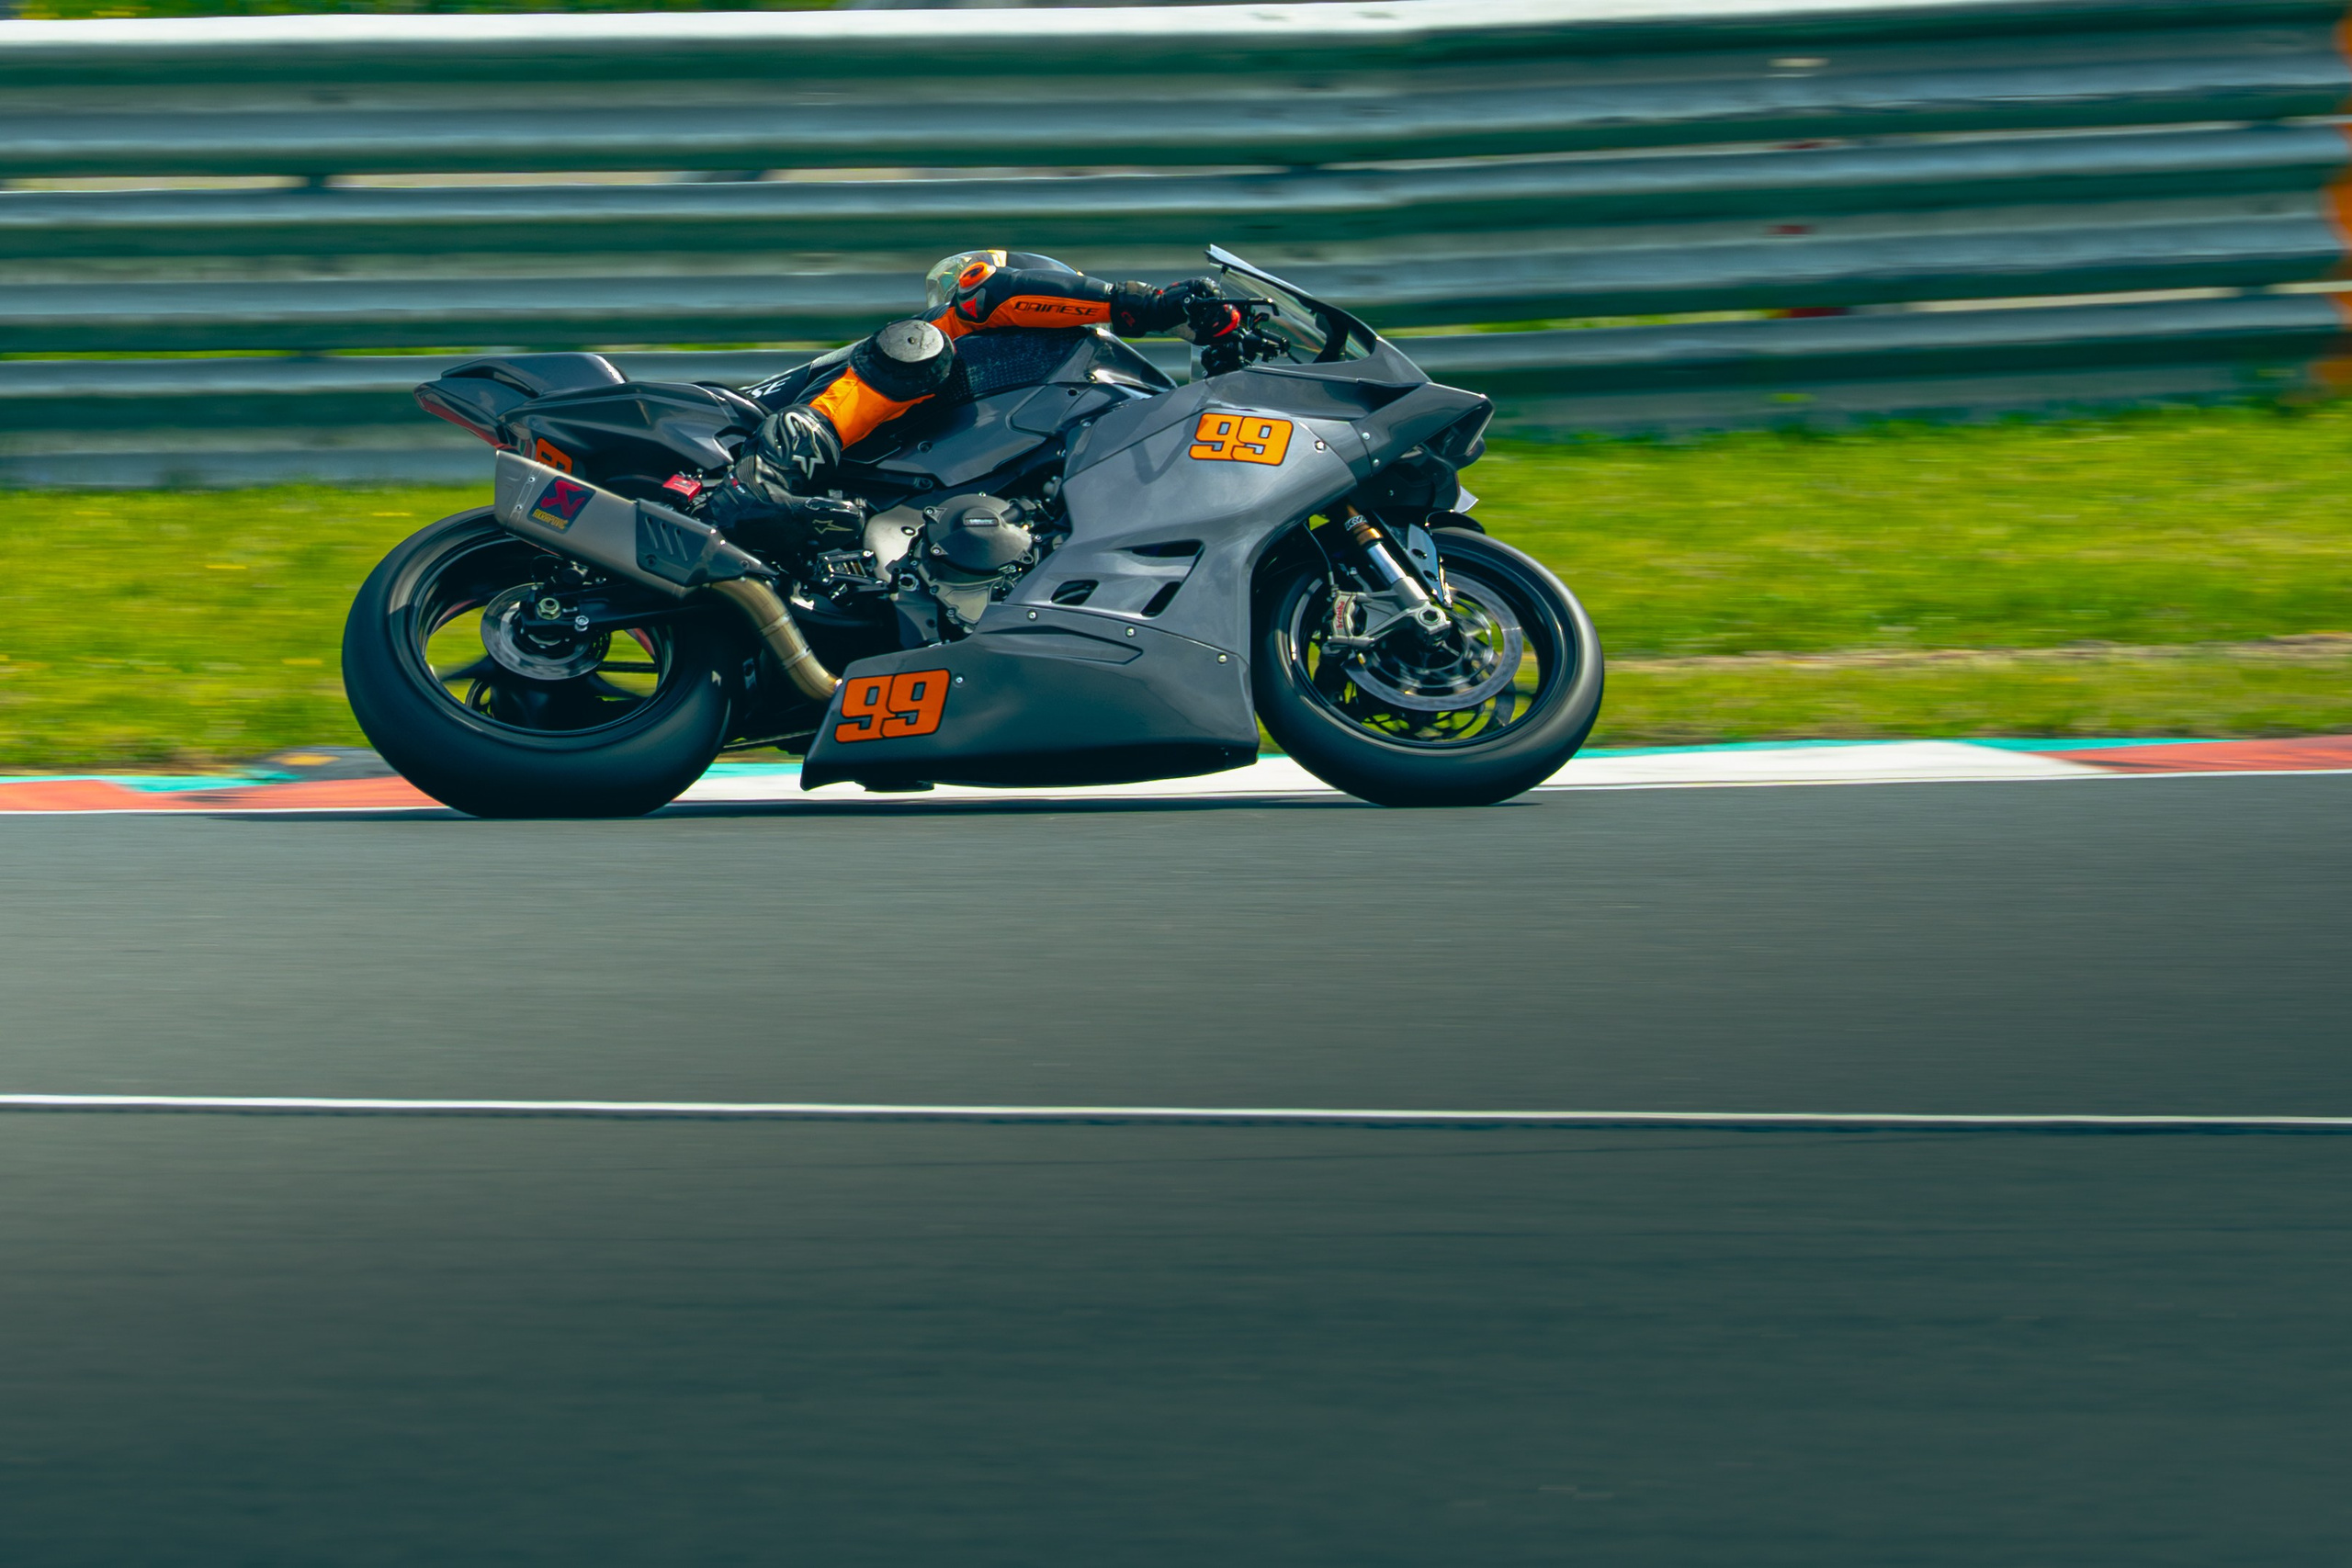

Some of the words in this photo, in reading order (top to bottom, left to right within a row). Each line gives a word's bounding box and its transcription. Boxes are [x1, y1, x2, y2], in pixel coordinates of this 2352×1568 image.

[1013, 300, 1100, 317] DAINESE
[745, 376, 792, 399] SE
[1188, 412, 1294, 467] 99
[834, 668, 951, 743] 99
